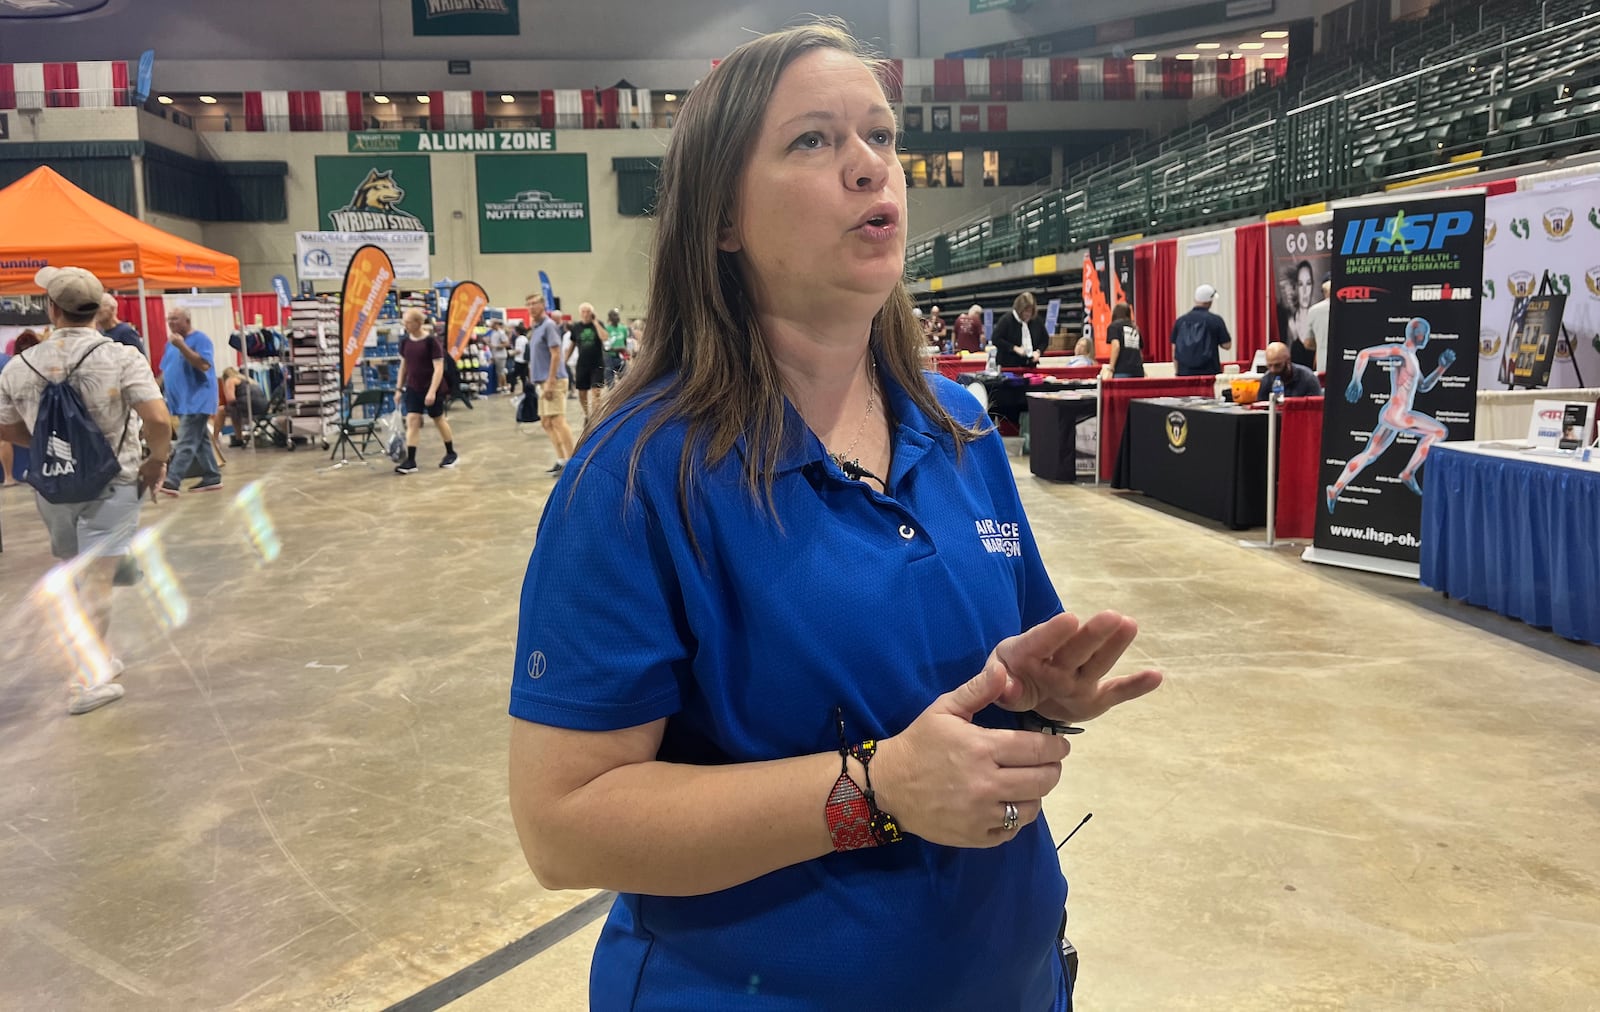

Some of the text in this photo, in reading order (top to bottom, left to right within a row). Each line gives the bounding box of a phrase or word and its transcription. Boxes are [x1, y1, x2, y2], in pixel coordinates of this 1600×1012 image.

[418, 132, 552, 150] ALUMNI ZONE
[333, 211, 424, 232] WRIGHT STATE
[486, 209, 584, 220] NUTTER CENTER
[1340, 210, 1474, 255] IHSP
[1286, 232, 1308, 254] GO
[1345, 260, 1461, 275] SPORTS PERFORMANCE
[1346, 255, 1409, 266] INTEGRATIVE
[1411, 253, 1450, 263] HEALTH
[975, 519, 996, 535] AIR
